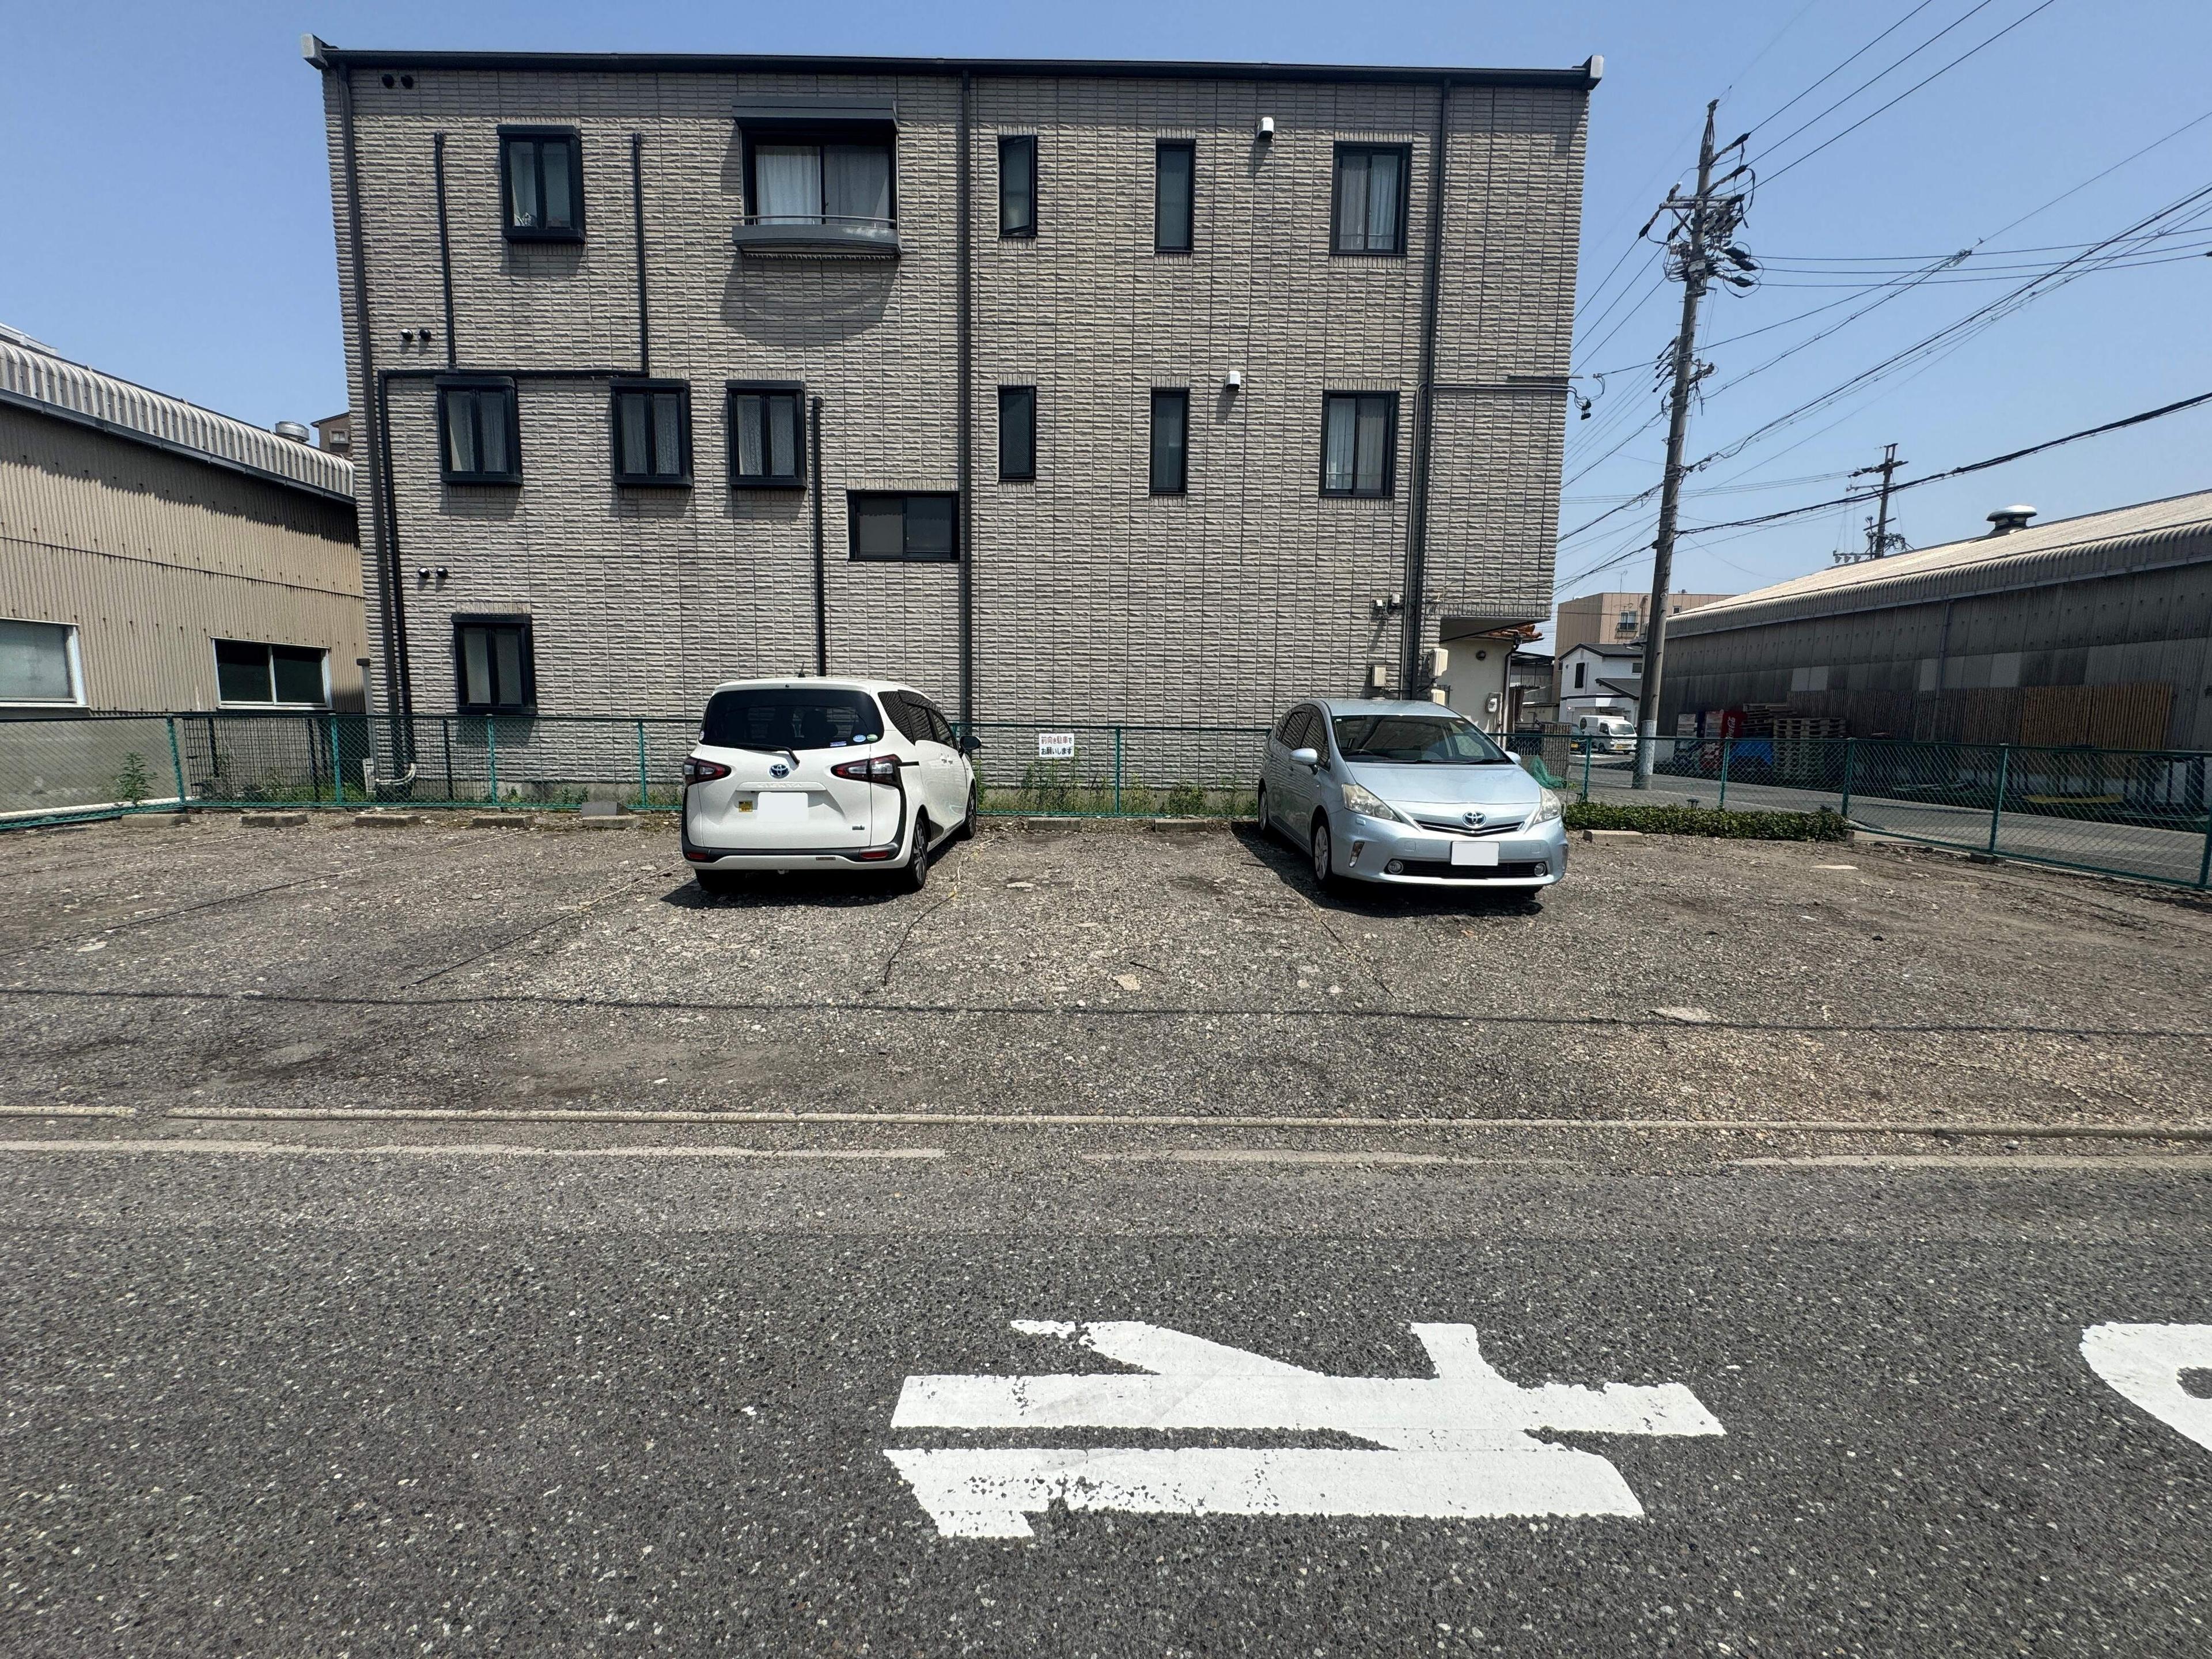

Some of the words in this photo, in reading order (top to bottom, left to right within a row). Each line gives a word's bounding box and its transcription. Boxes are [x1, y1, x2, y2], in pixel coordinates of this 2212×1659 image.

[1041, 736, 1073, 744] 前向き駐車で
[1041, 747, 1072, 755] お願いします
